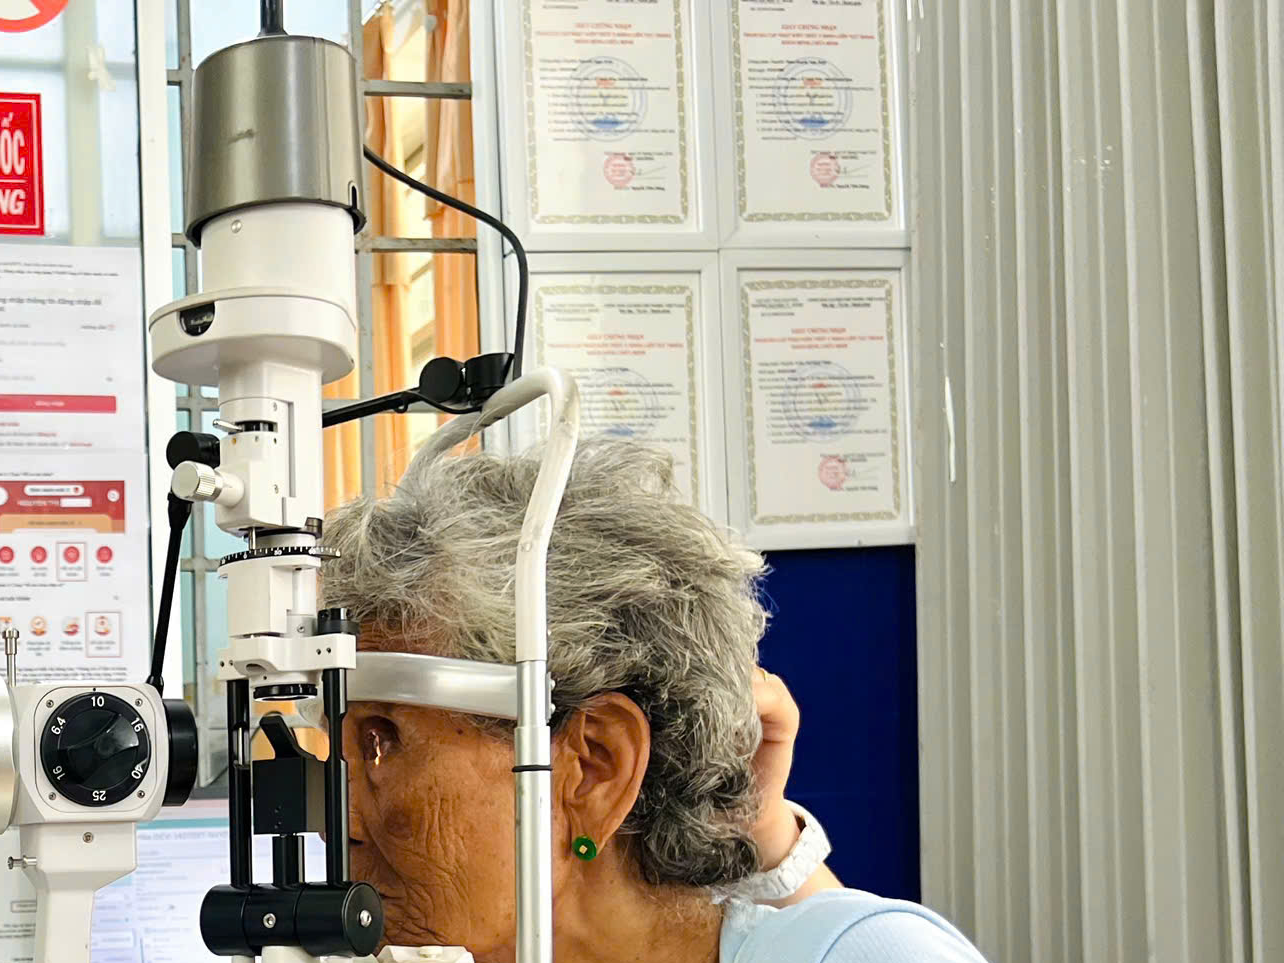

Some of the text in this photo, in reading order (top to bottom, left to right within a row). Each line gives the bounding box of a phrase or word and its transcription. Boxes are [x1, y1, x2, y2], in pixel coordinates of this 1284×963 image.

[90, 696, 105, 707] 10
[51, 716, 66, 735] 6.4
[130, 717, 144, 733] 16
[52, 765, 66, 781] 16
[131, 763, 145, 780] 40
[92, 790, 107, 801] 25
